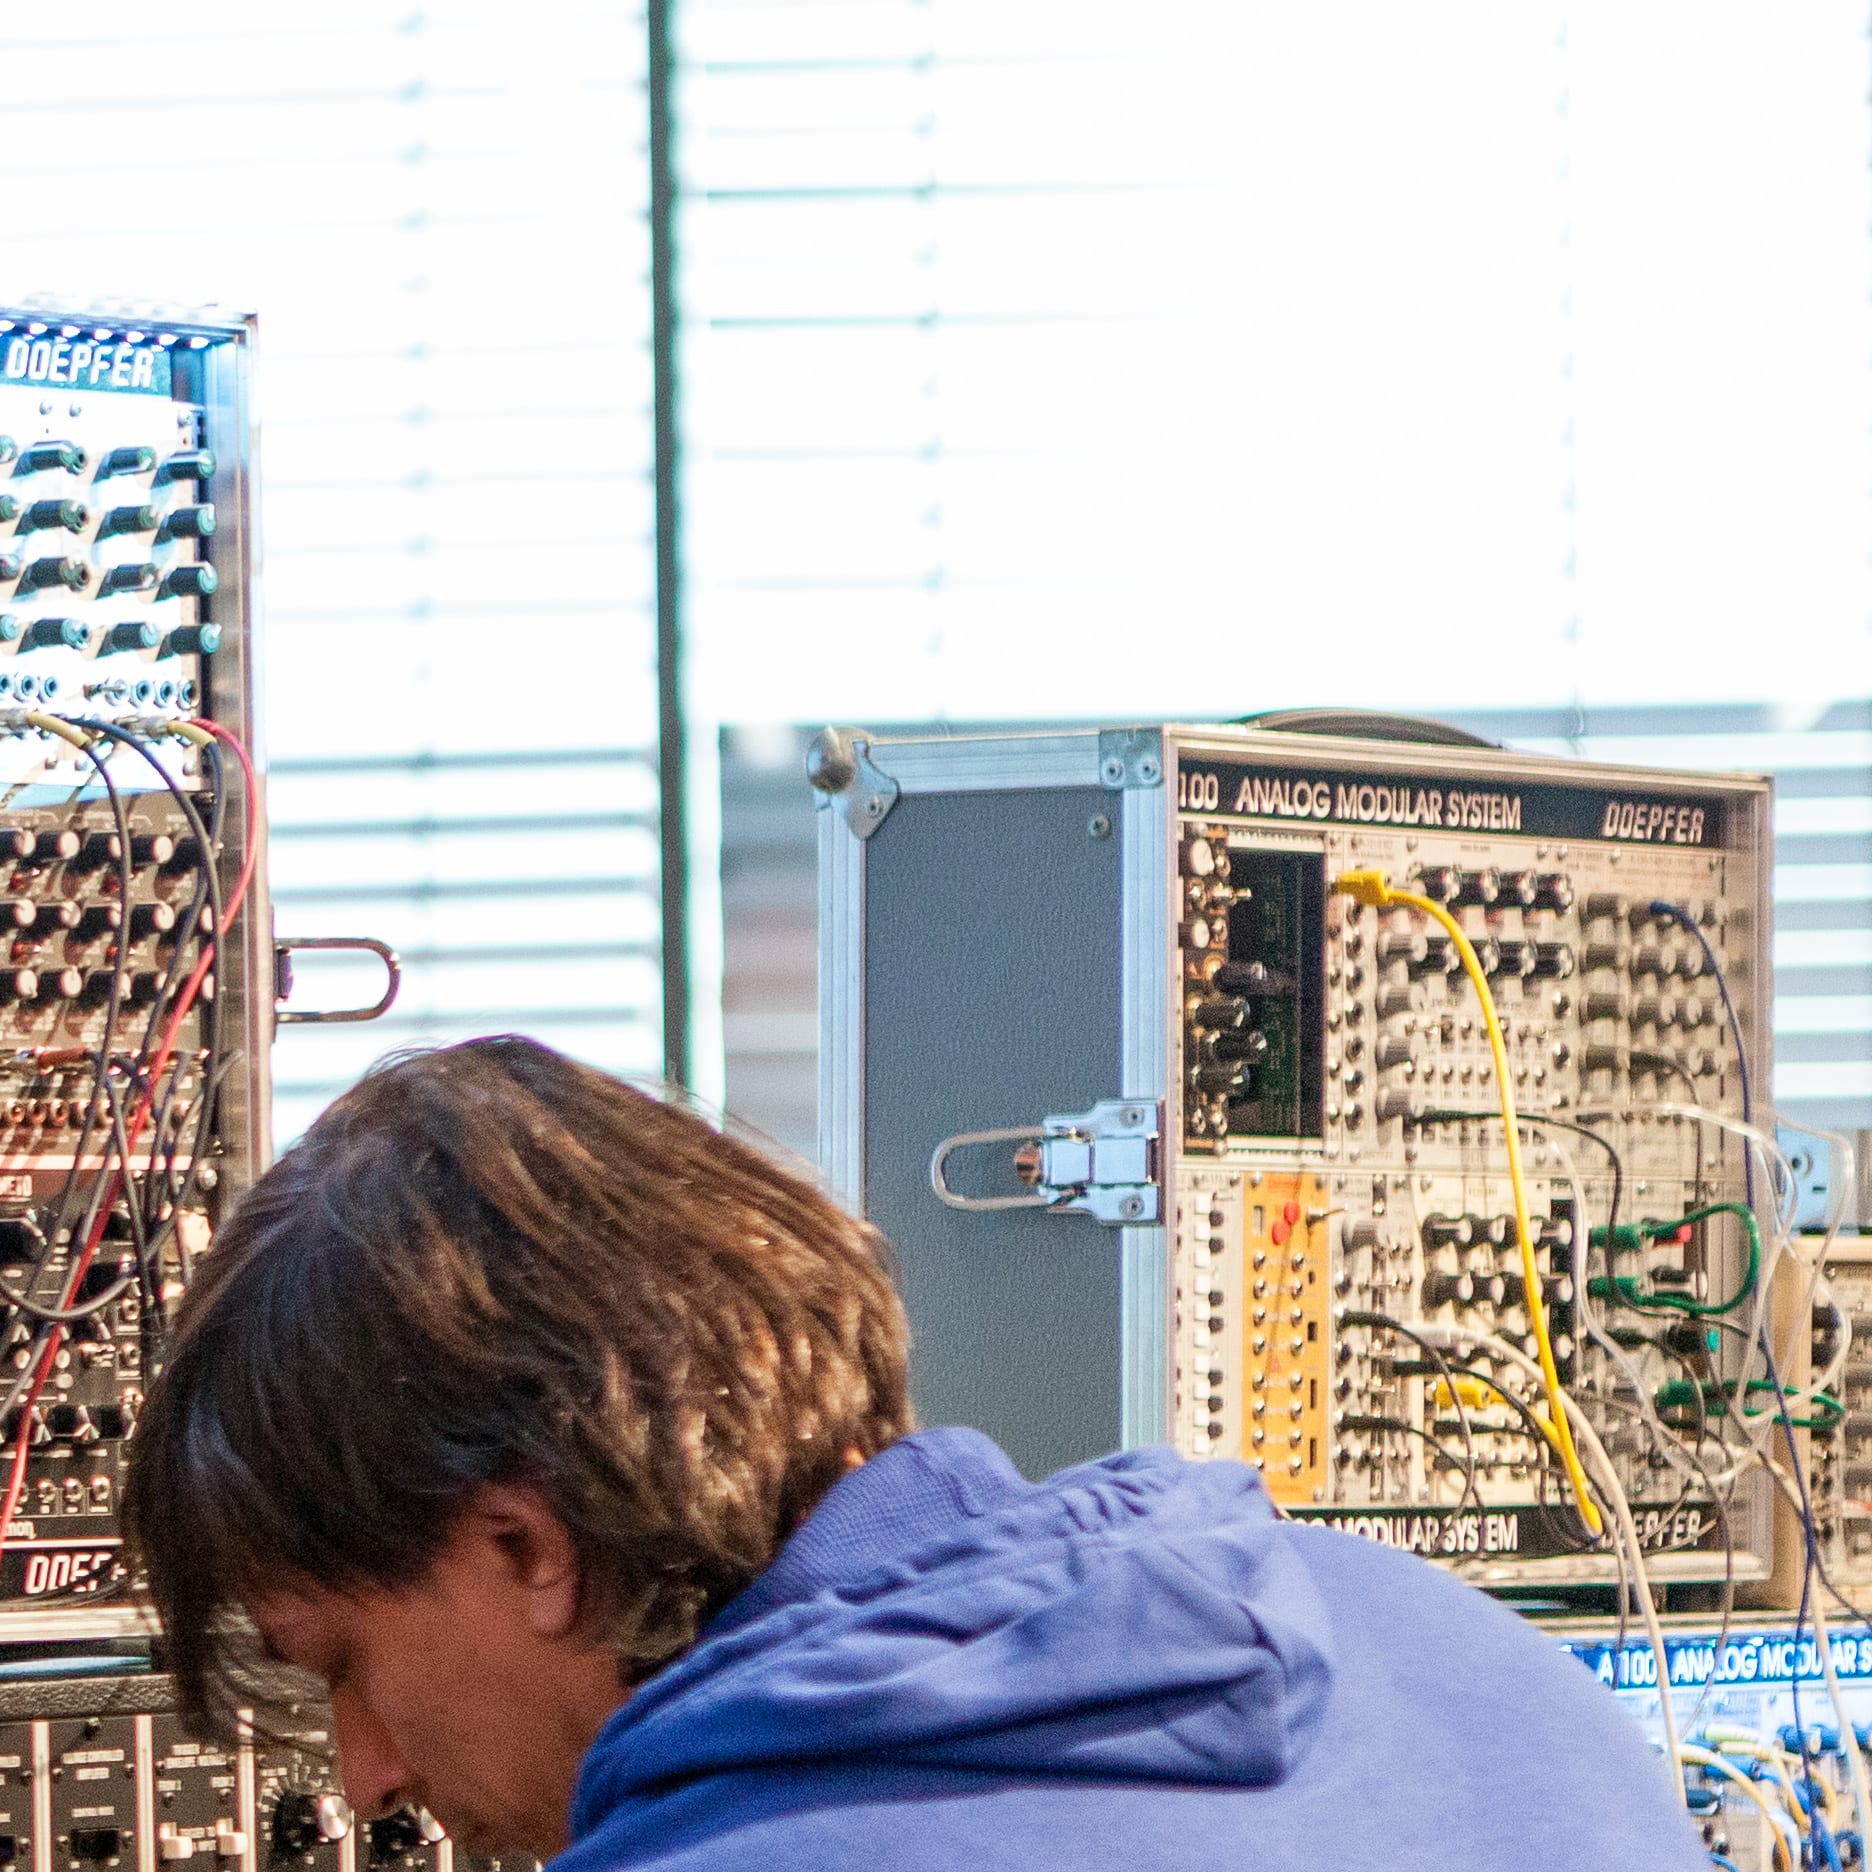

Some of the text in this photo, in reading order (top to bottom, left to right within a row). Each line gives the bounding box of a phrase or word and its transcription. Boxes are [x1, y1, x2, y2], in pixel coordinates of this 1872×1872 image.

[5, 340, 155, 388] DOEPFER
[1235, 777, 1331, 820] ANALOG
[1335, 783, 1443, 826] MODULAR
[1446, 791, 1522, 831] SYSTEM
[1604, 801, 1706, 844] DOEPFER
[1442, 1513, 1519, 1552] SYSEM
[1760, 1640, 1858, 1679] MODUAR
